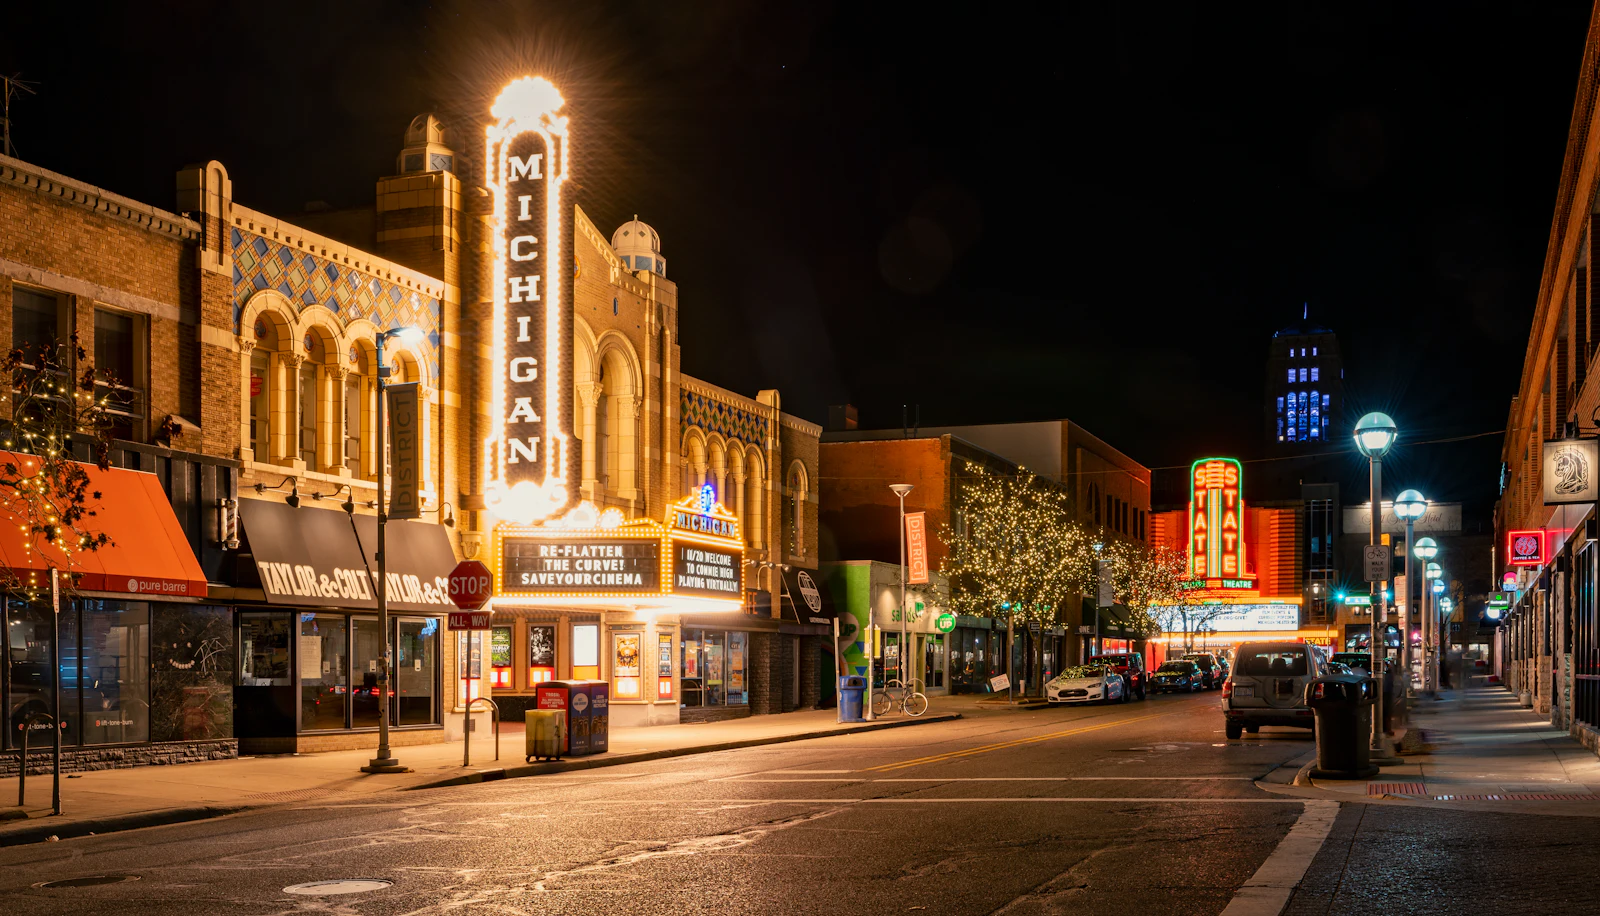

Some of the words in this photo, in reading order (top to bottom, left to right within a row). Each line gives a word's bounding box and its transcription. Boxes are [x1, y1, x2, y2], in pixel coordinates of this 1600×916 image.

[508, 153, 543, 464] MICHIGAN
[395, 396, 412, 506] DISTRICT
[676, 511, 735, 538] MICHIGAN
[1195, 466, 1207, 575] STATE
[1224, 466, 1237, 574] STATE
[1416, 512, 1443, 524] Hotel
[540, 545, 623, 558] RE-FLATTEN
[911, 519, 924, 577] DISTRICT
[544, 559, 573, 571] THE
[575, 558, 625, 571] CURVE!
[686, 548, 703, 563] 11/20
[704, 551, 732, 566] WELCOME
[686, 562, 696, 575] TO
[139, 581, 160, 593] pure
[162, 580, 186, 593] barre
[450, 576, 489, 595] STOP
[521, 573, 643, 585] SAVEYOURCINEMA
[678, 574, 705, 589] PLAYING
[705, 577, 738, 592] VIRTUALLY
[1223, 579, 1253, 589] THEATRE
[450, 617, 466, 628] ALL
[471, 616, 489, 627] WAY
[891, 605, 916, 624] salds
[939, 621, 953, 629] UP
[1305, 637, 1331, 645] STATE
